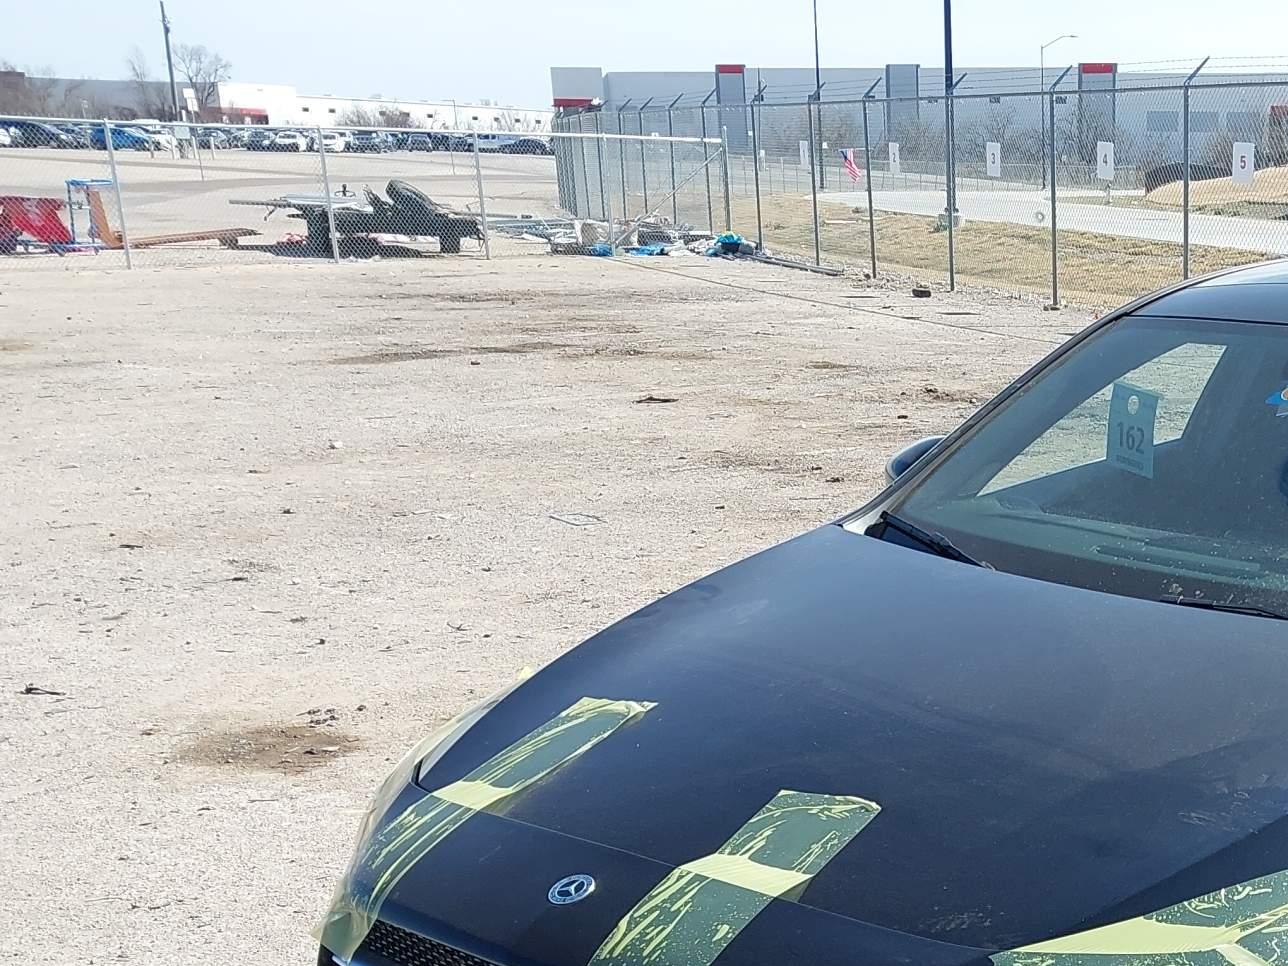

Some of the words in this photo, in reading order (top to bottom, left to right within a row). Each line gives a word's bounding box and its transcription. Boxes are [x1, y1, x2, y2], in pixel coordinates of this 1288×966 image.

[892, 152, 897, 163] 2
[990, 152, 997, 165] 3
[1102, 153, 1108, 167] 4
[1239, 155, 1247, 170] 5
[1116, 421, 1145, 455] 162
